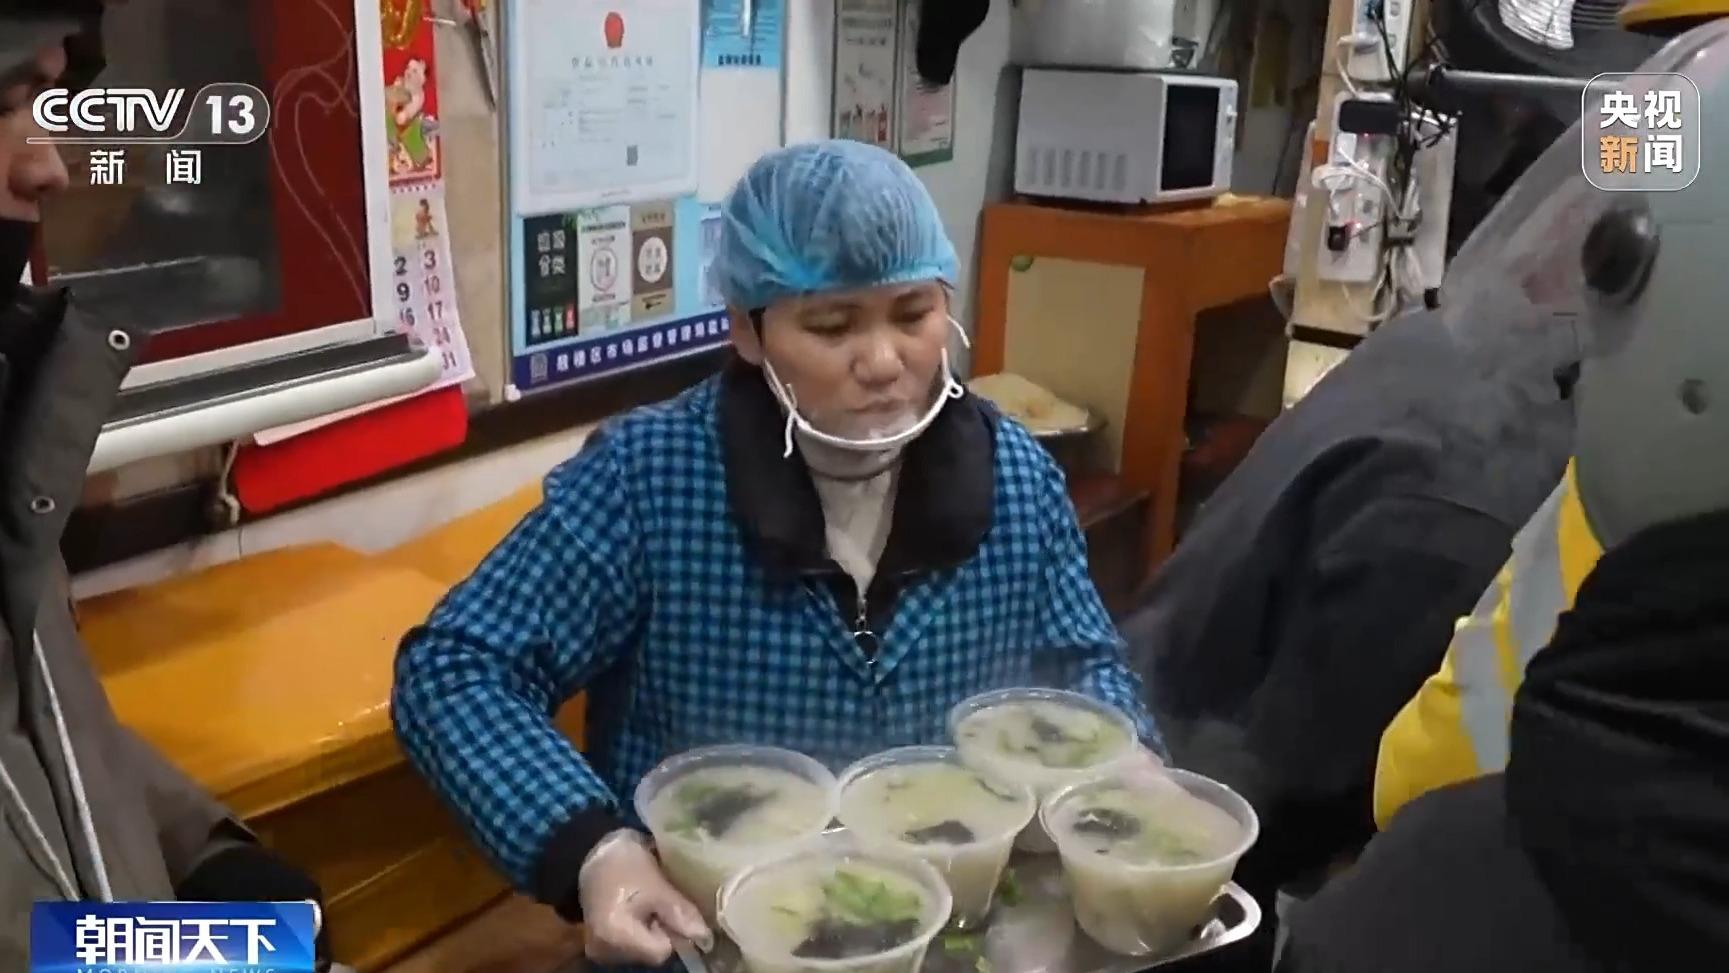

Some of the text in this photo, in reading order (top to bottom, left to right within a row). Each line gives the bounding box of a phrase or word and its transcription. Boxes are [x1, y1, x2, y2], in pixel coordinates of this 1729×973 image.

[394, 250, 436, 276] 2 3
[396, 276, 440, 302] 9 10
[427, 301, 442, 320] 17
[441, 351, 457, 370] 31
